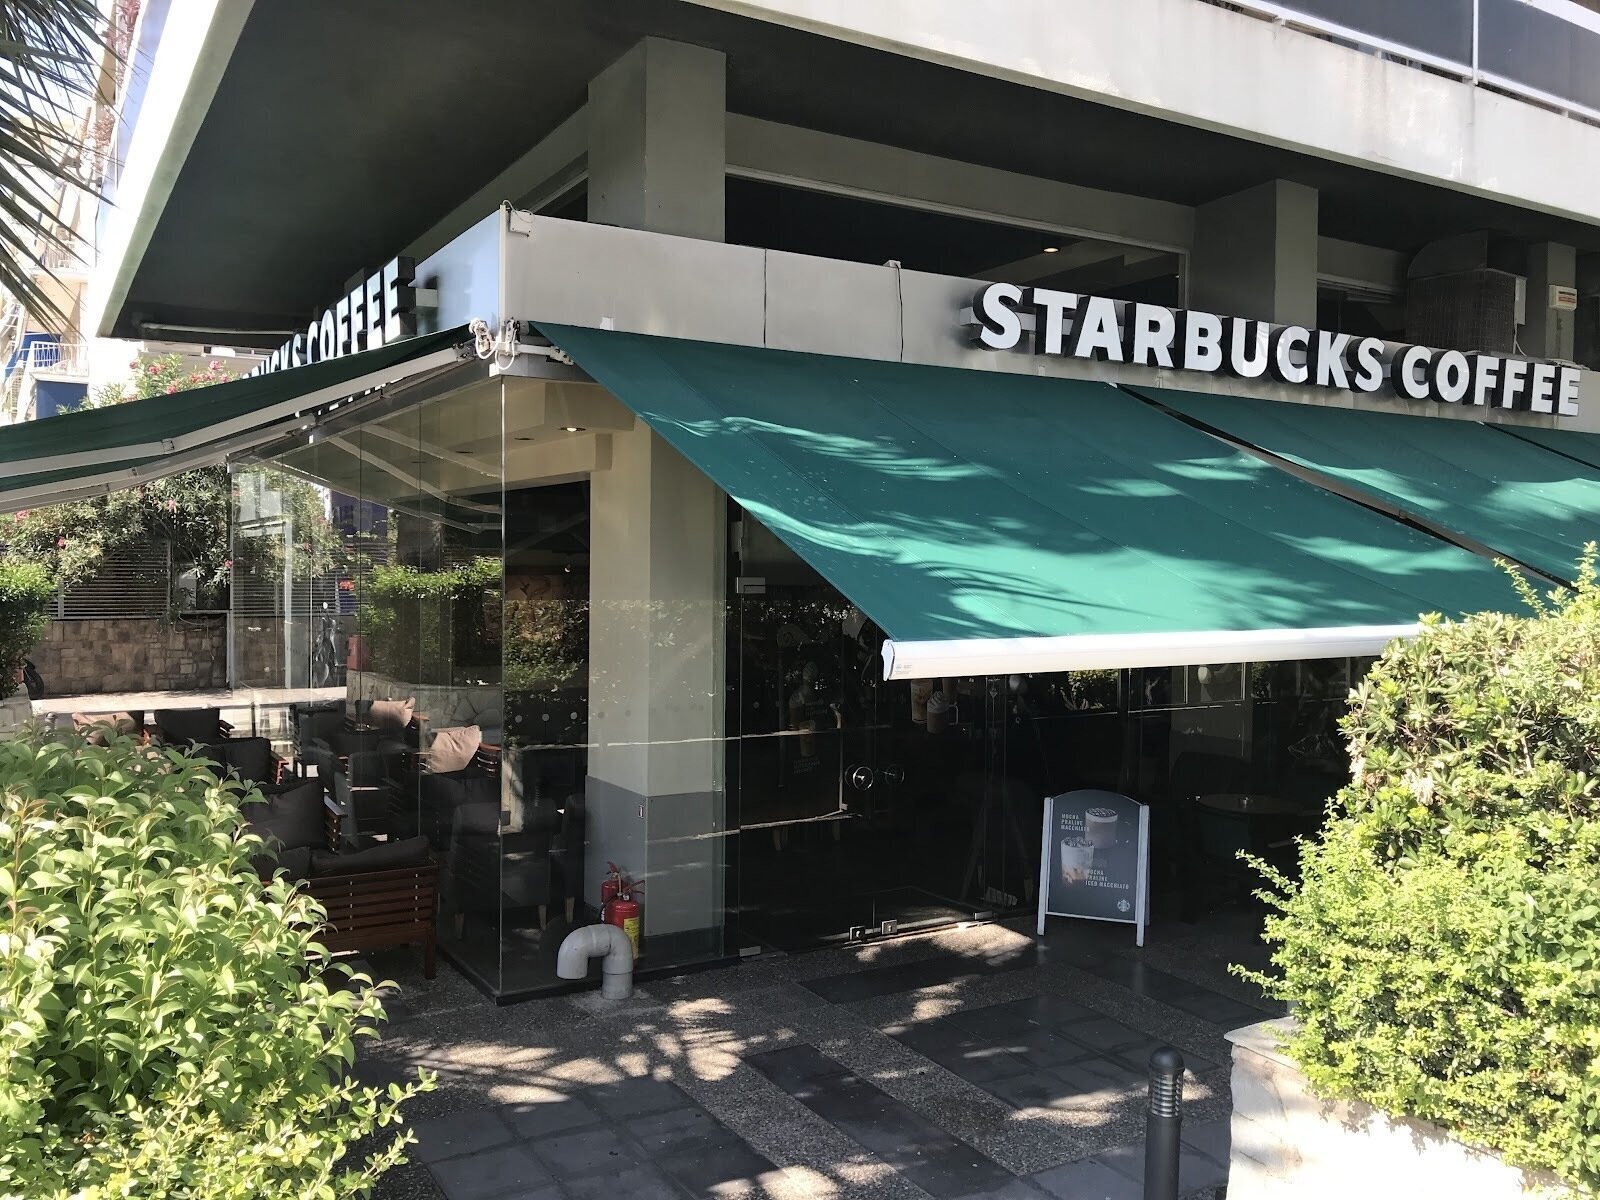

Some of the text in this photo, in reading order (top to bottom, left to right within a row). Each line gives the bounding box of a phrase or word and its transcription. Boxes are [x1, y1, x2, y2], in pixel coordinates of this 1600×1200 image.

[306, 256, 400, 363] COFFEE
[980, 282, 1581, 416] STARBUCKS COFFEE
